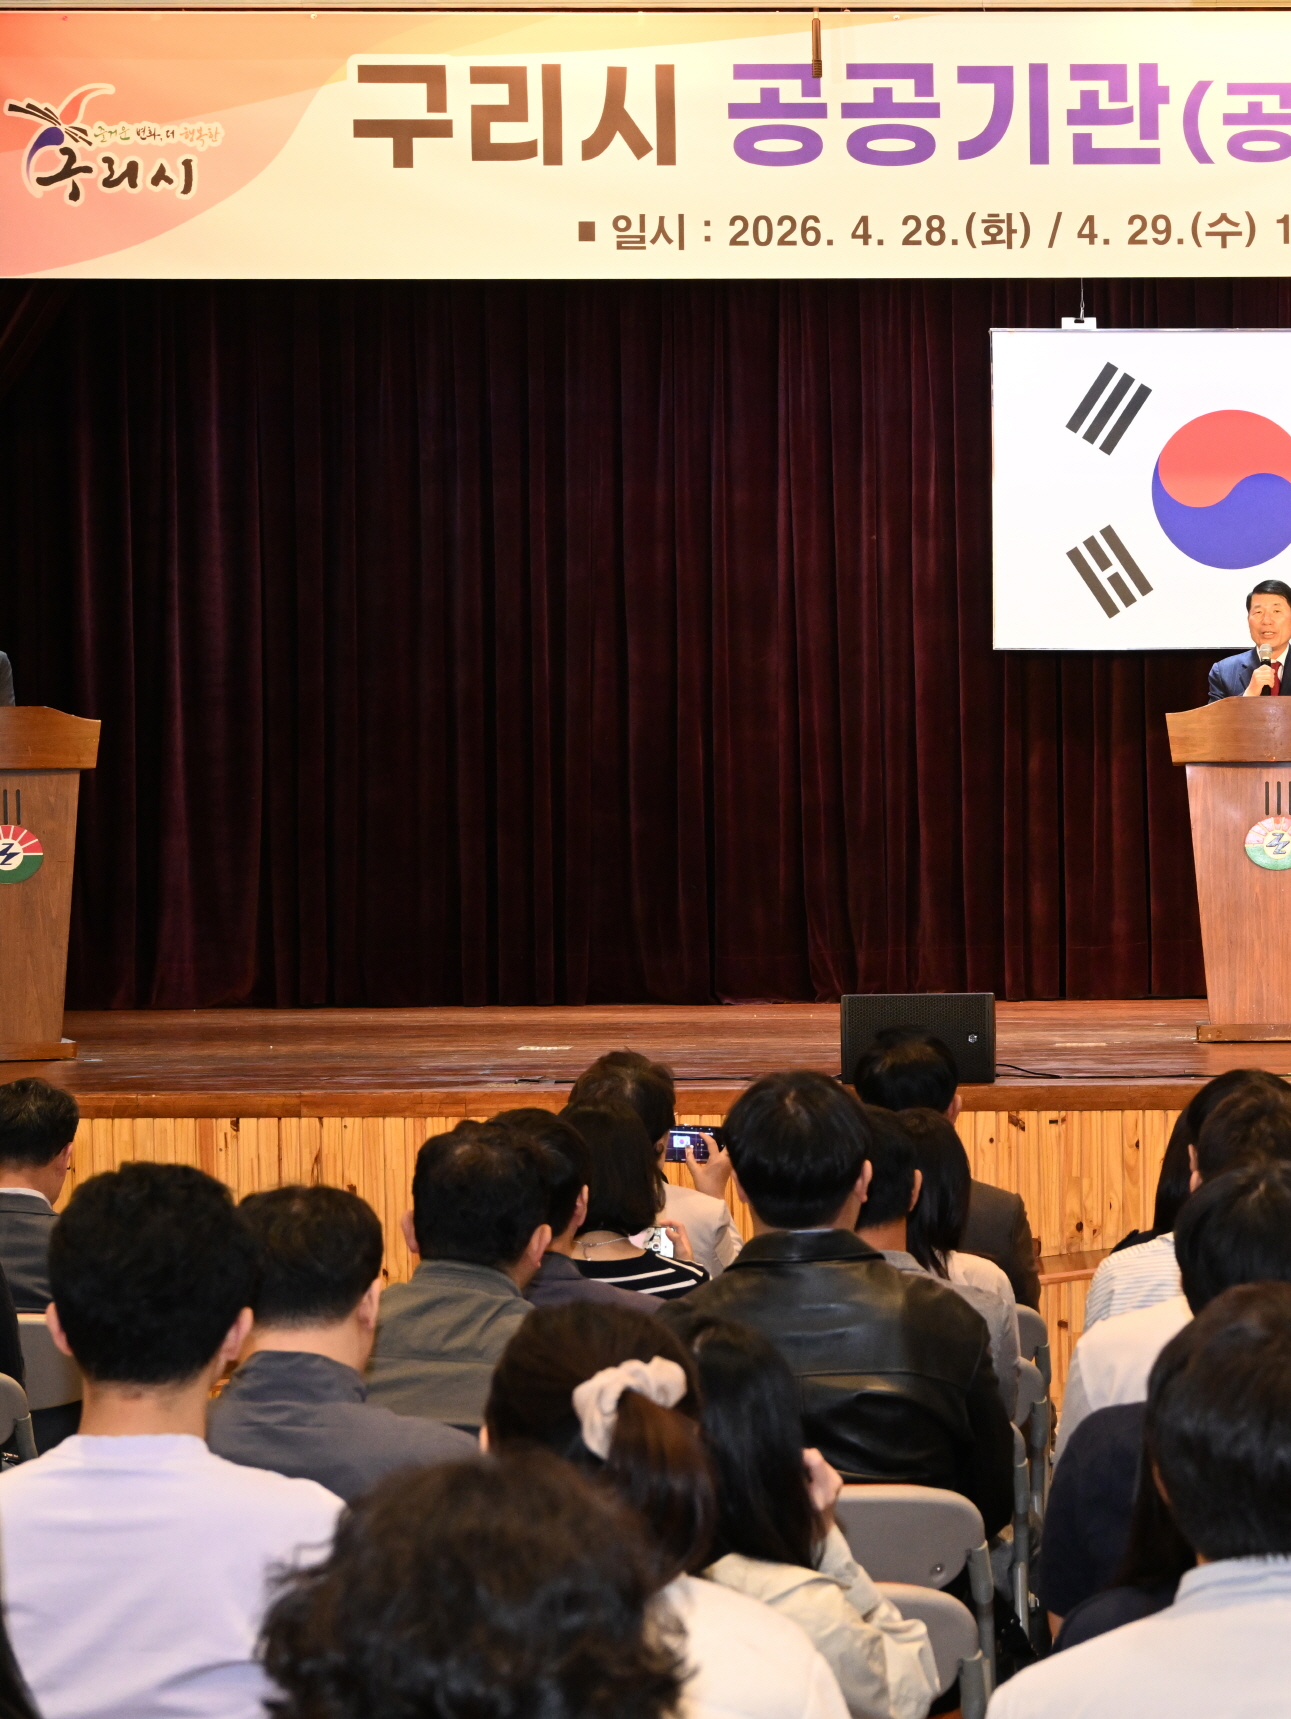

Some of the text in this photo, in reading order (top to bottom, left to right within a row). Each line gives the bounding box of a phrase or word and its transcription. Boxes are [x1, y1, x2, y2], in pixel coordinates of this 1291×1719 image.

[93, 125, 131, 143] 즐거운
[165, 129, 175, 139] 더
[179, 126, 220, 147] 행복한
[353, 64, 677, 168] 구리시
[36, 147, 193, 202] 구리시
[612, 213, 685, 250] 일시
[729, 214, 834, 246] 2026.
[851, 215, 884, 246] 4.
[902, 212, 1031, 249] 28.(화)
[1077, 214, 1110, 246] 4.
[1128, 211, 1256, 248] 29.(수)
